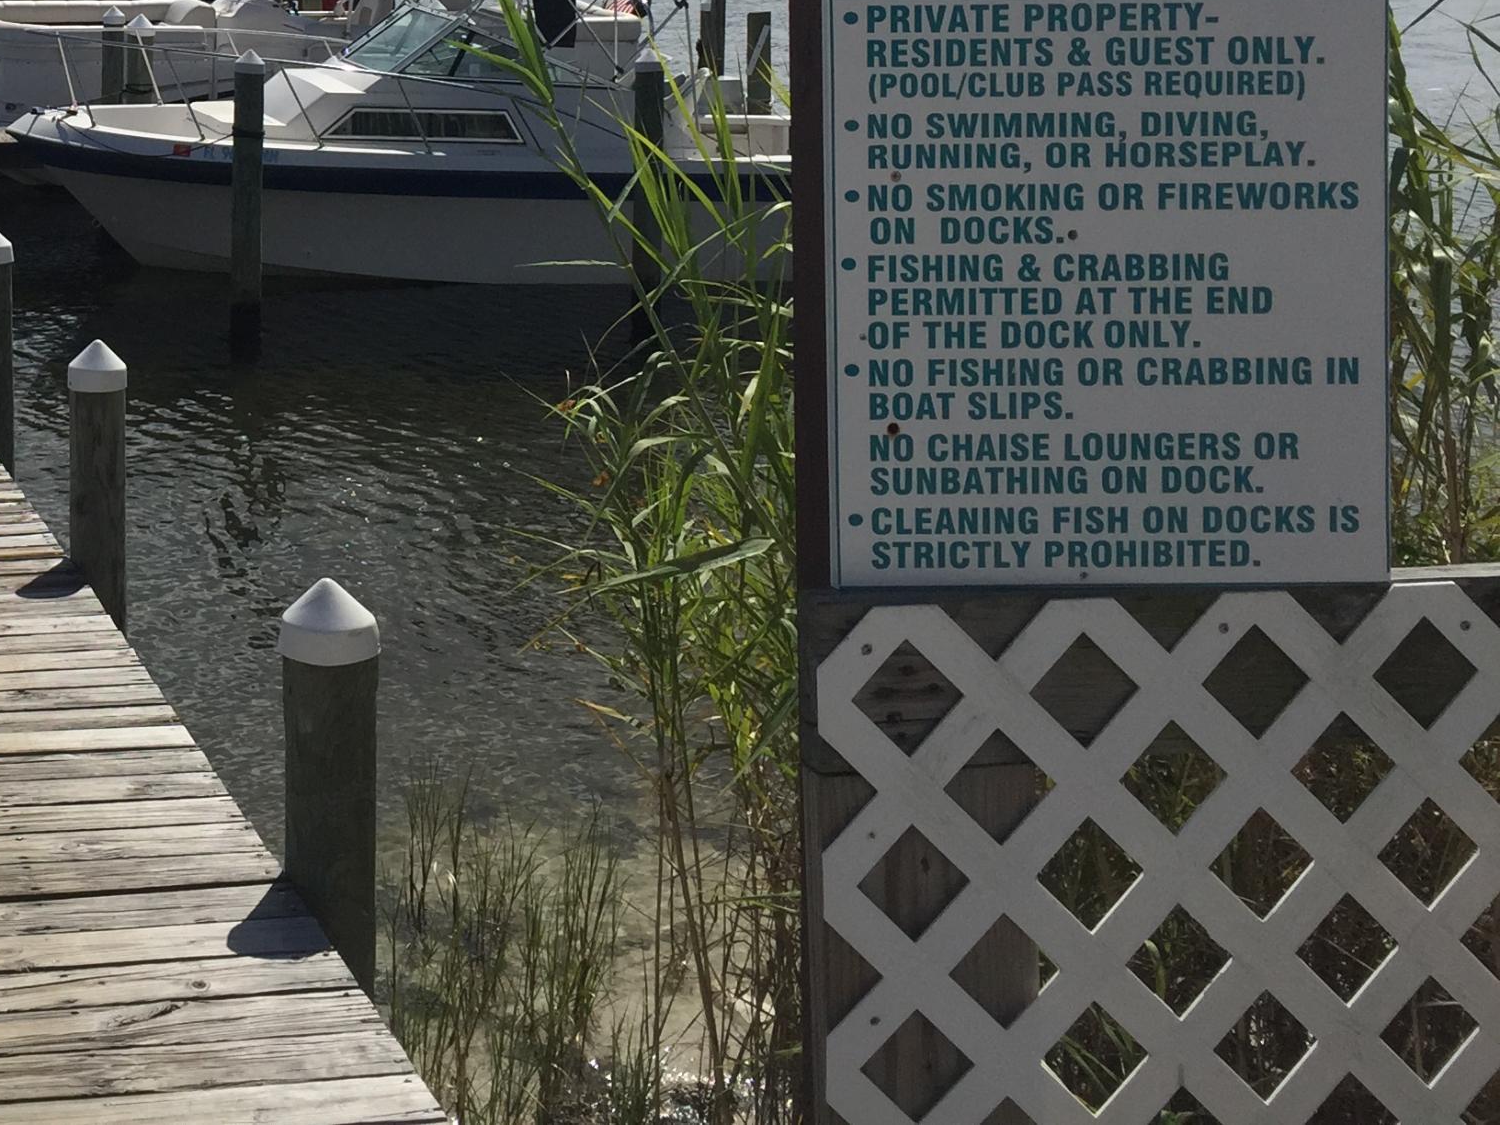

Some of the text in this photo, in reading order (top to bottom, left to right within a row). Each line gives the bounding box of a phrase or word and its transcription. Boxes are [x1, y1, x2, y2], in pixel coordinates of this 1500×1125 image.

[867, 3, 1218, 33] PRIVATE PROPERTY-
[867, 36, 1324, 67] RESIDENTS & GUEST ONLY.
[869, 71, 1304, 103] (POOL/CLUB PASS REQUIRED)
[868, 111, 1268, 142] NO SWIMMING, DIVING,
[868, 141, 1315, 173] RUNNING, OR HORSEPLAY.
[868, 182, 1358, 212] NO SMOKING OR FIREWORKS
[871, 216, 1064, 244] ON DOCKS.
[868, 253, 1228, 282] FISHING & CRABBING
[868, 287, 1272, 315] PERMITTED AT THE END
[868, 320, 1200, 349] OF THE DOCK ONLY.
[869, 357, 1358, 387] NO FISHING OR CRABBING IN
[870, 391, 1073, 420] BOAT SLIPS.
[870, 432, 1298, 462] NO CHAISE LOUNGERS OR
[871, 466, 1263, 495] SUNBATHING ON DOCK.
[872, 506, 1359, 535] CLEANING FISH ON DOCKS IS
[872, 540, 1260, 569] STRICTLY PROHIBITED.
